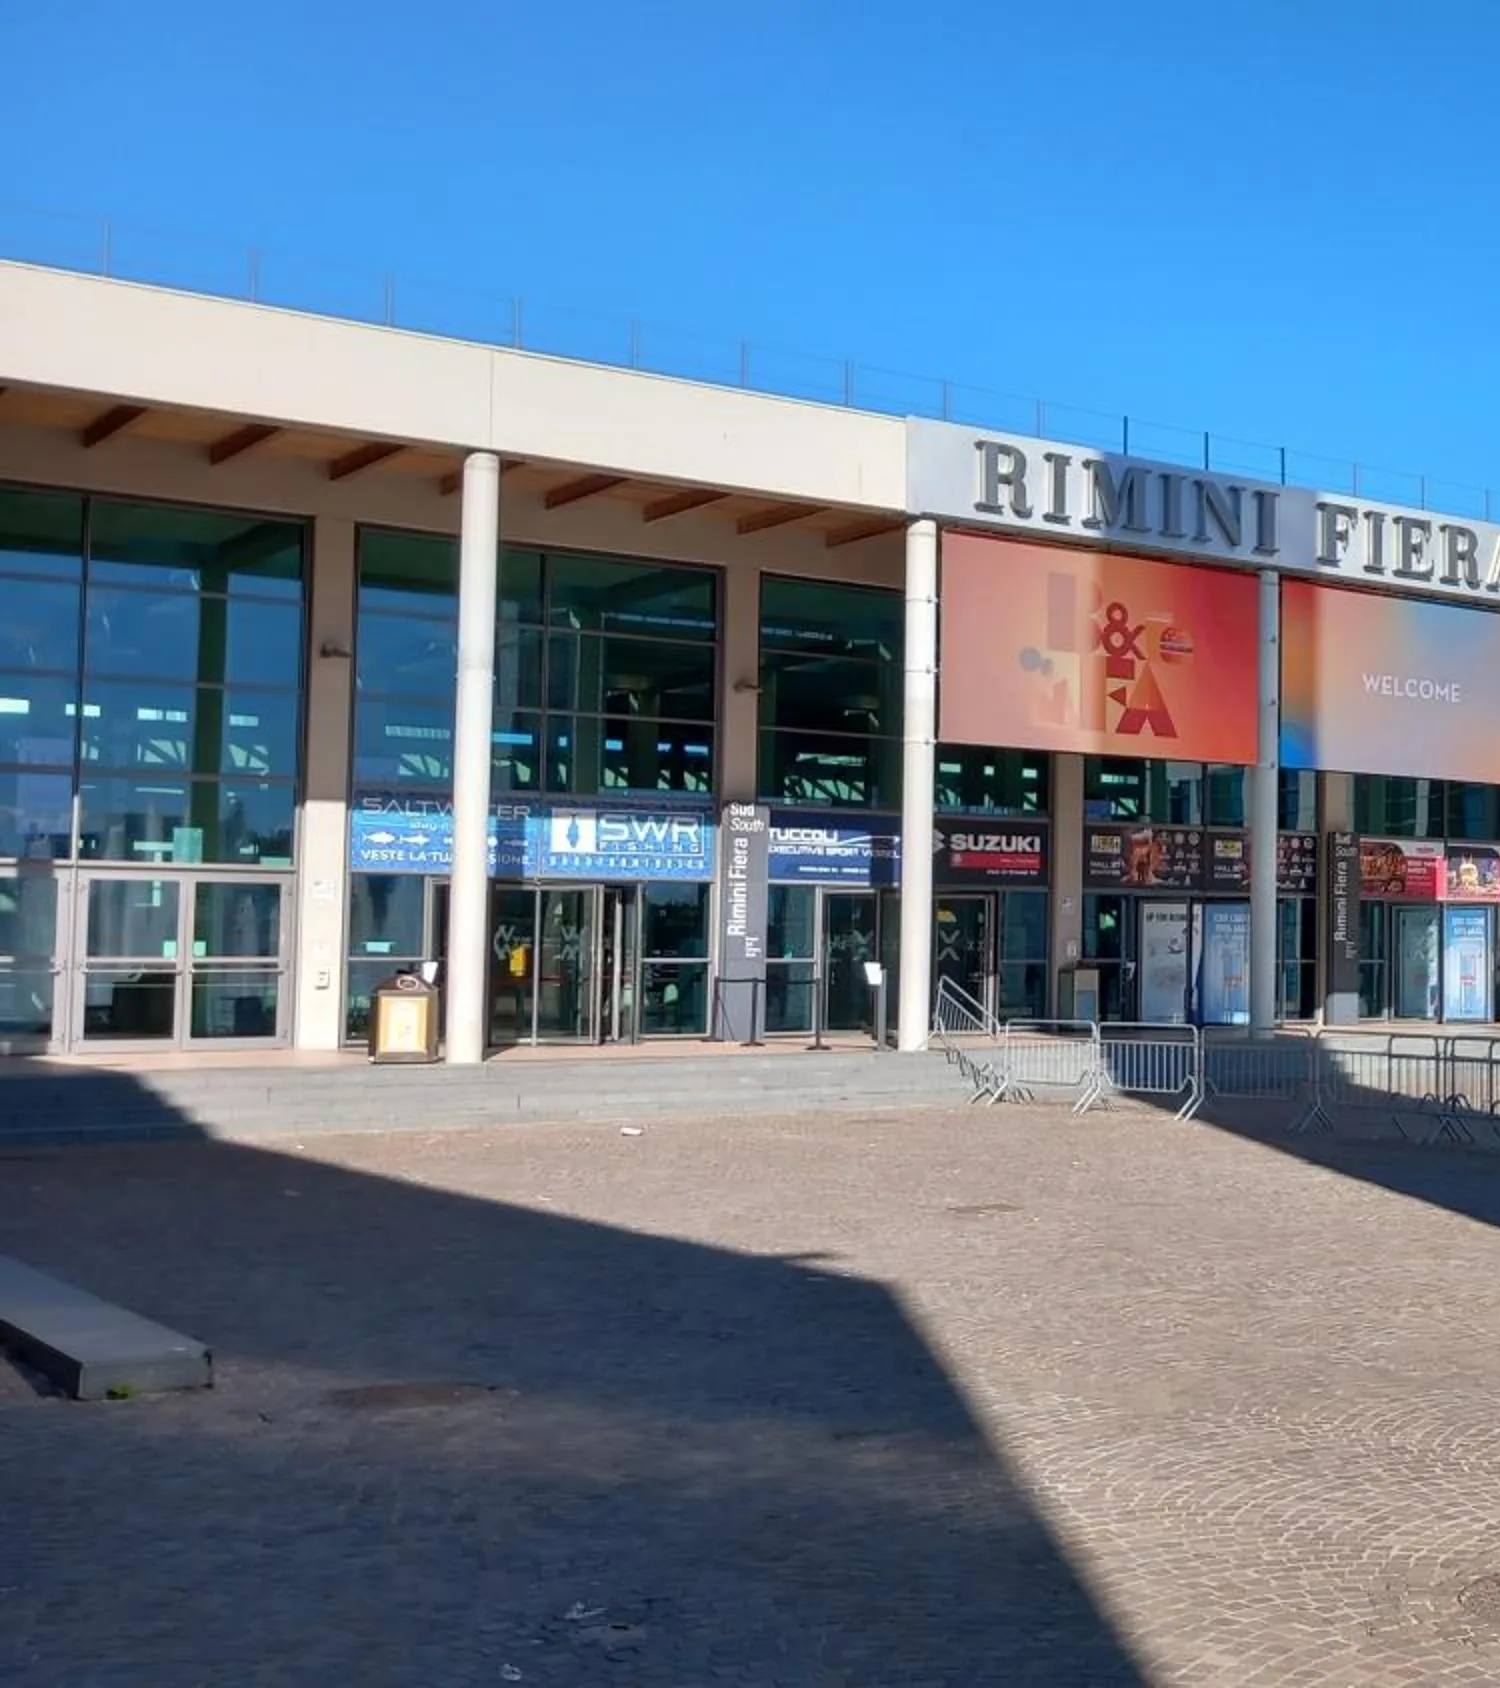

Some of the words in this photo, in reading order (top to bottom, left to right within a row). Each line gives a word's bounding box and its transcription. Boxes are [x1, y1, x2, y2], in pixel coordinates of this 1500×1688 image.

[974, 440, 1280, 556] RIMINI
[1361, 672, 1461, 702] WELCOME
[362, 797, 531, 820] SALTWER
[730, 803, 755, 816] Sud
[600, 814, 700, 843] SWR
[730, 817, 765, 832] South
[951, 833, 1040, 852] SUZUKI
[361, 849, 405, 861] VESTE
[409, 851, 427, 862] LA
[432, 852, 453, 863] TU
[728, 837, 749, 879] Fiera
[727, 884, 747, 936] Rimini
